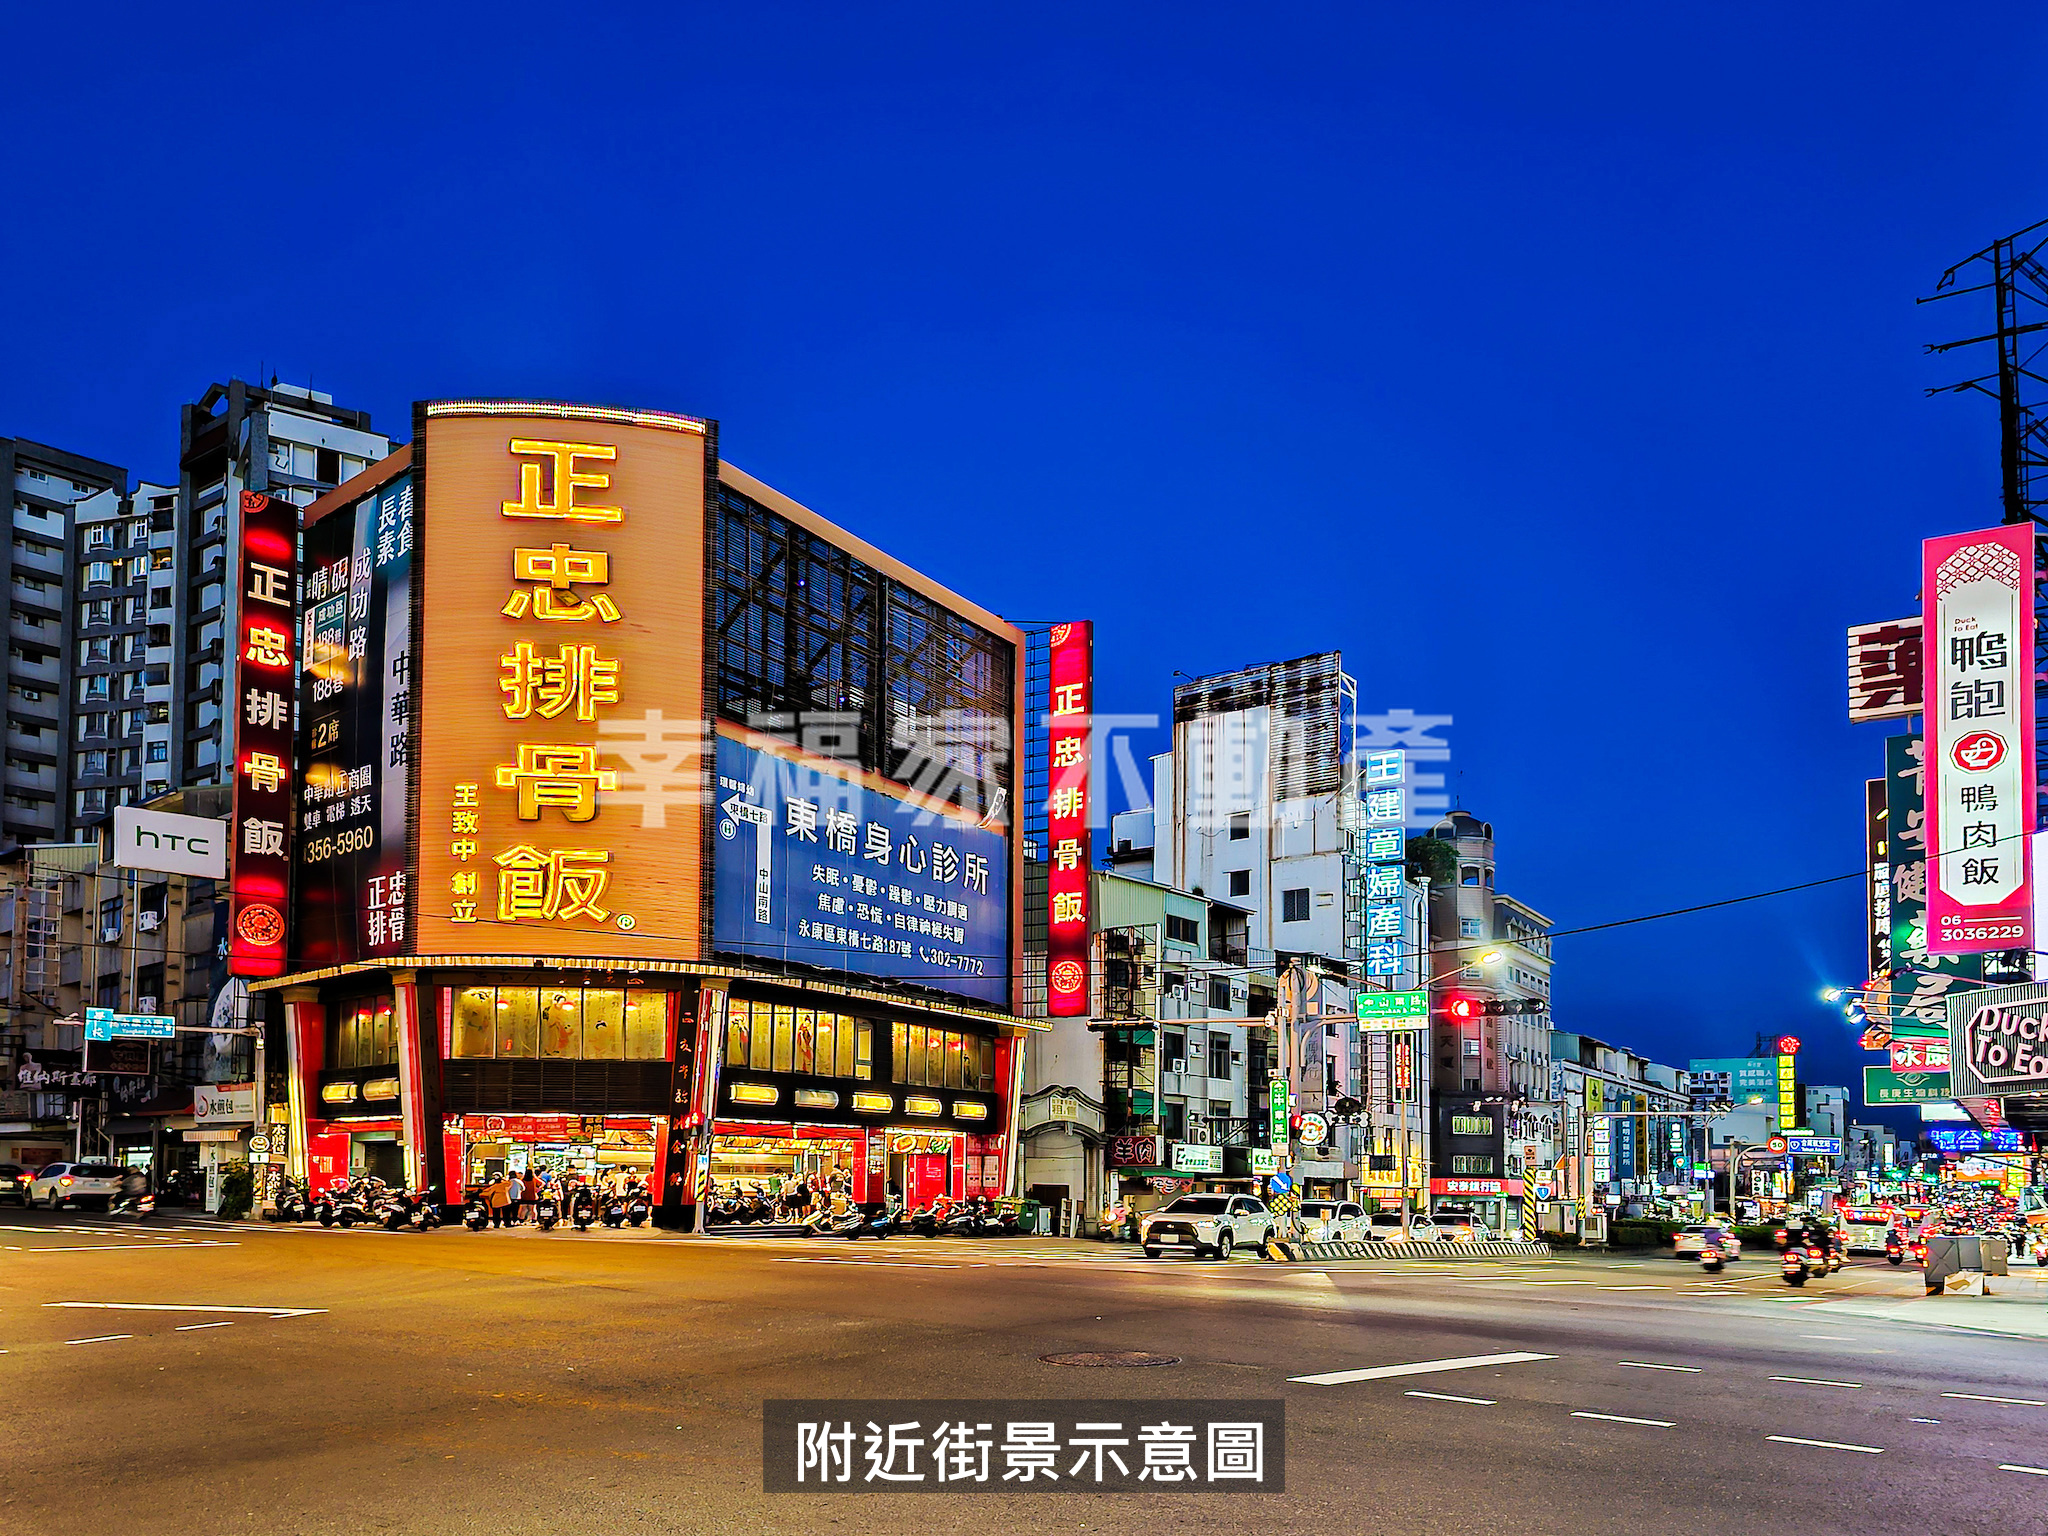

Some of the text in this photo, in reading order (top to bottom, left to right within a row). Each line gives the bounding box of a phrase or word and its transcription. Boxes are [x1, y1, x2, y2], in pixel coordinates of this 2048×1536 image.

[348, 547, 371, 662] 成功路
[242, 561, 291, 857] 正忠排骨飯
[312, 674, 344, 703] 188巷
[494, 437, 625, 923] 正忠排骨飯
[450, 783, 479, 923] 王致中 創立
[729, 803, 769, 825] 東橋七路
[785, 796, 990, 896] 東橋身心診所
[1052, 682, 1085, 924] 正忠排骨飯
[1961, 783, 1999, 885] 鴨肉飯
[758, 868, 769, 922] 中山南路
[1368, 752, 1402, 974] 王建章婦產科
[798, 918, 984, 976] 永康區東橋七路187號 302-7772
[1940, 925, 2024, 941] 3036229
[1941, 915, 1962, 925] 06
[1114, 1138, 1156, 1163] 羊肉
